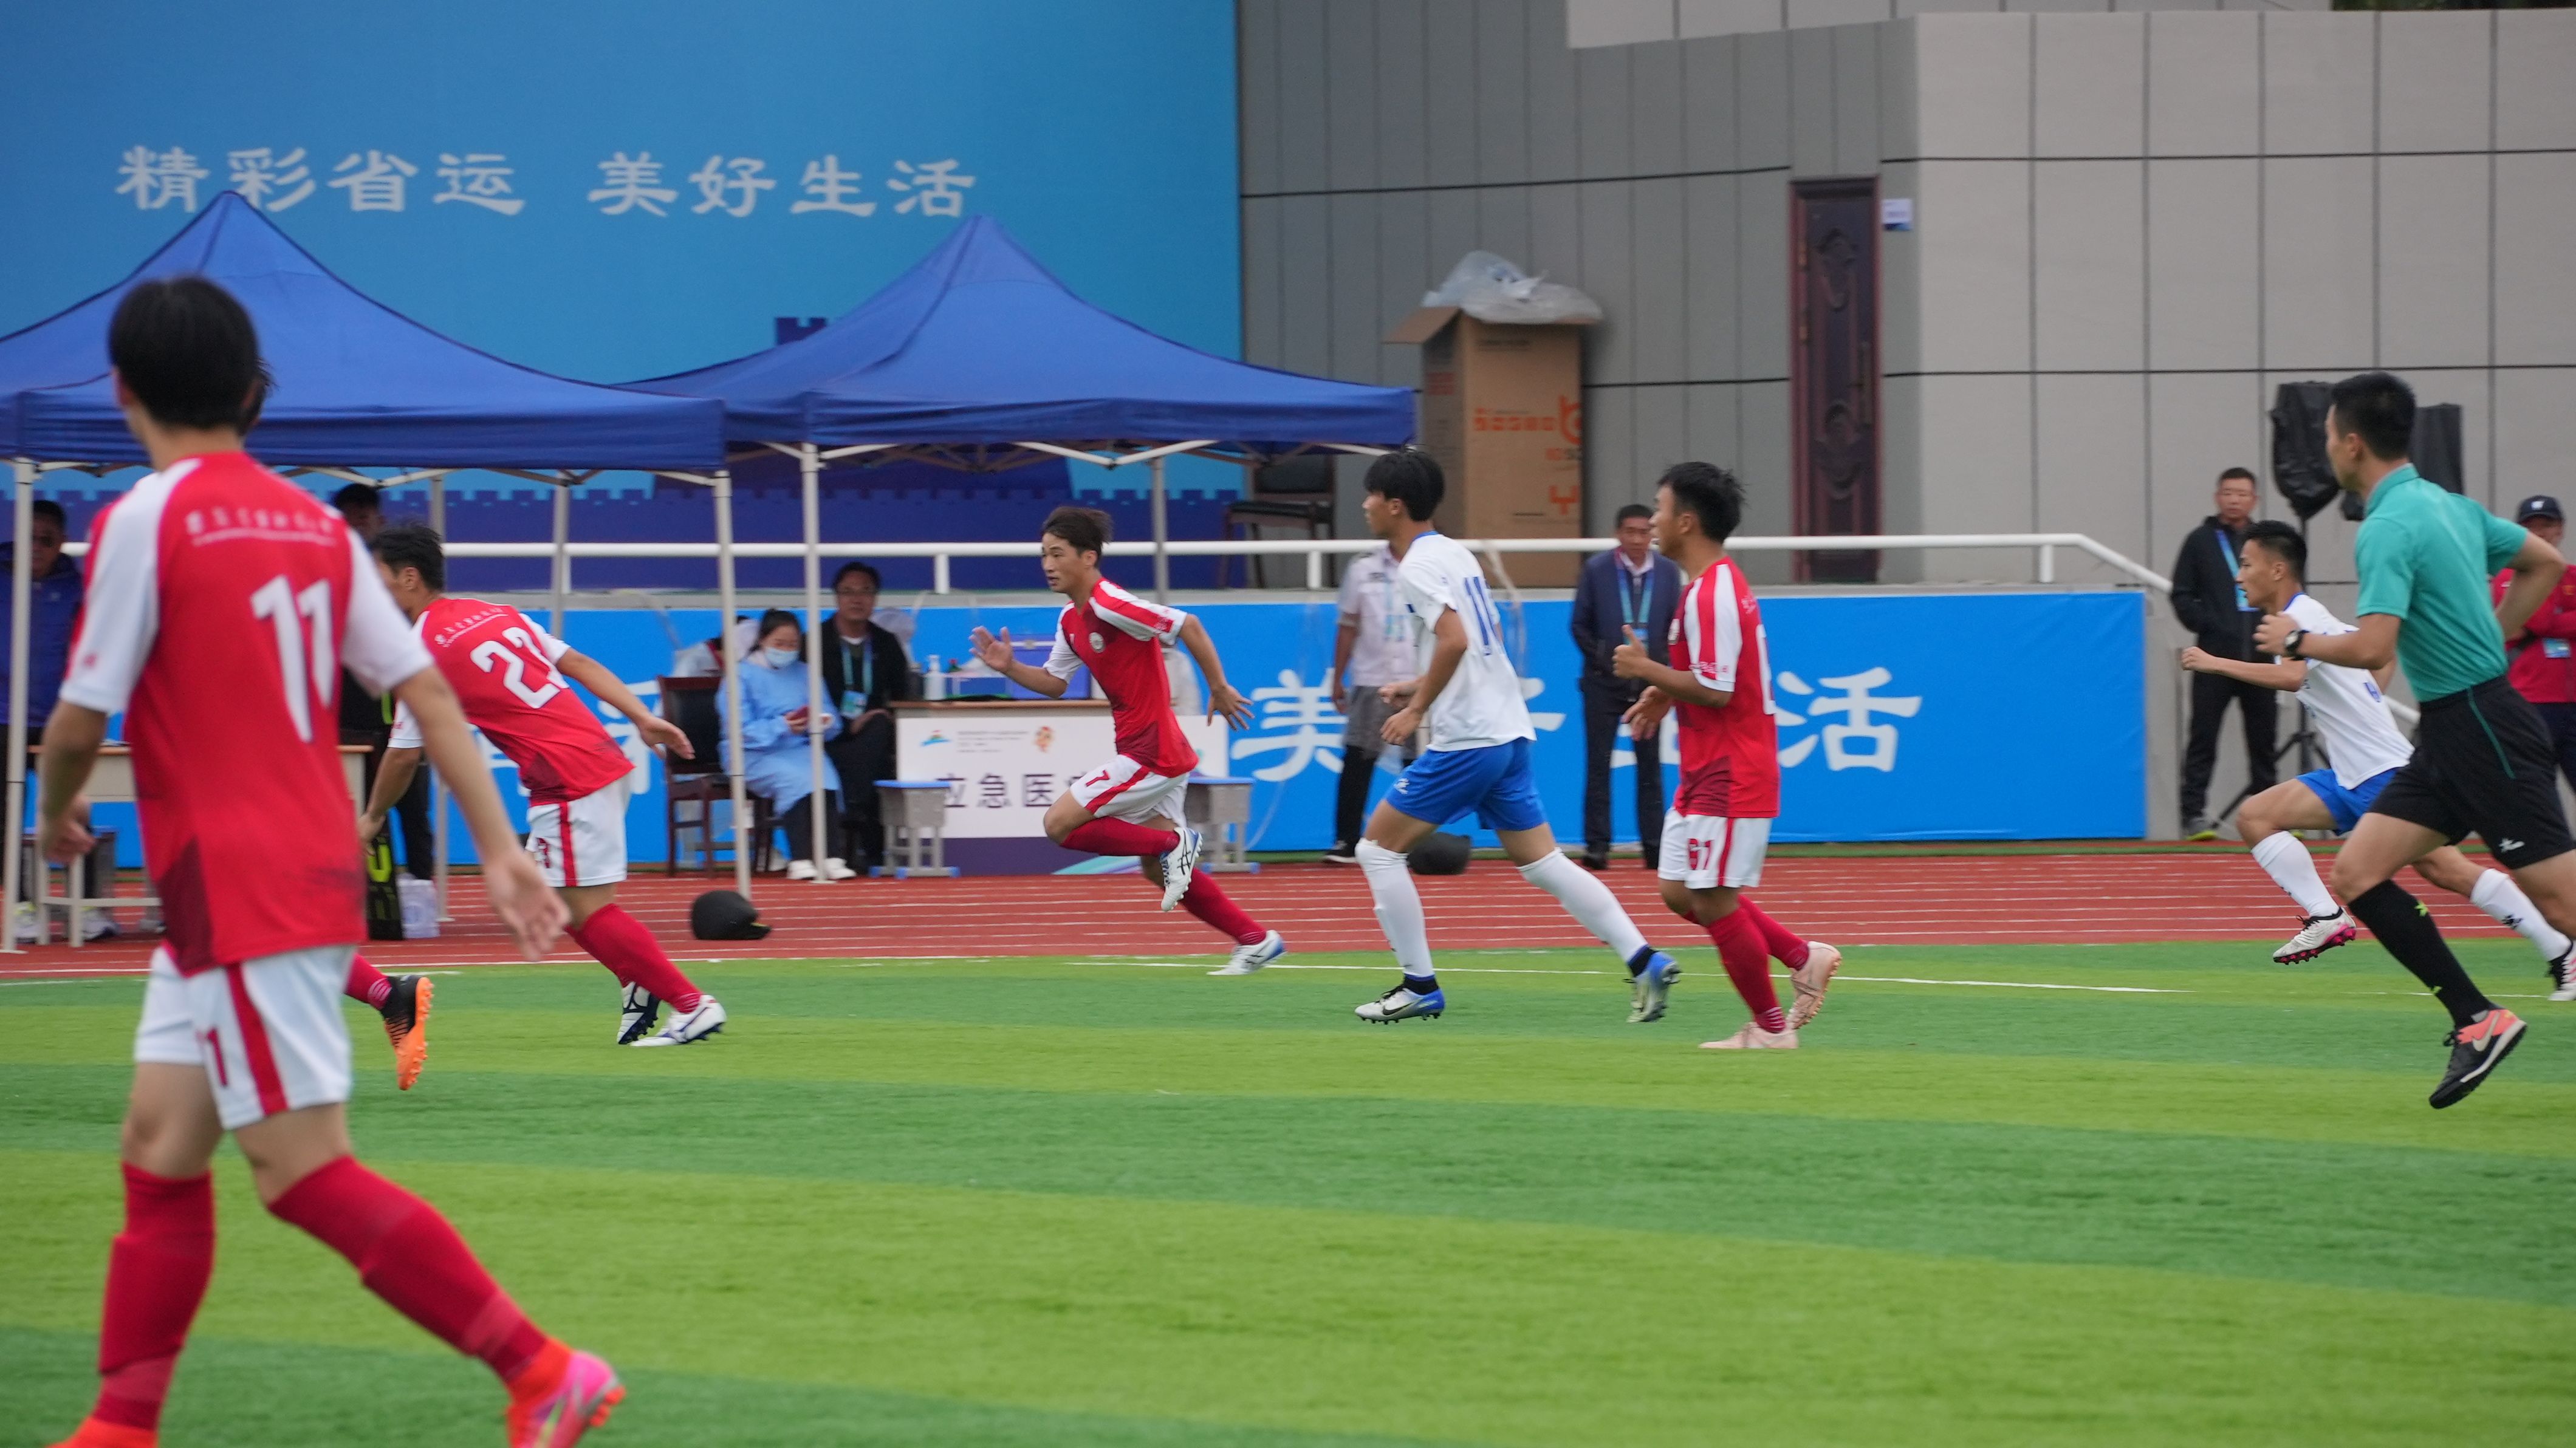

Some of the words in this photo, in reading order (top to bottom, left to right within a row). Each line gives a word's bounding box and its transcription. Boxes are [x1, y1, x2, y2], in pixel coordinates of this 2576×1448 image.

[116, 146, 524, 215] 精彩省运
[587, 151, 976, 217] 美好生活
[250, 574, 334, 744] 11
[1084, 770, 1111, 788] 7
